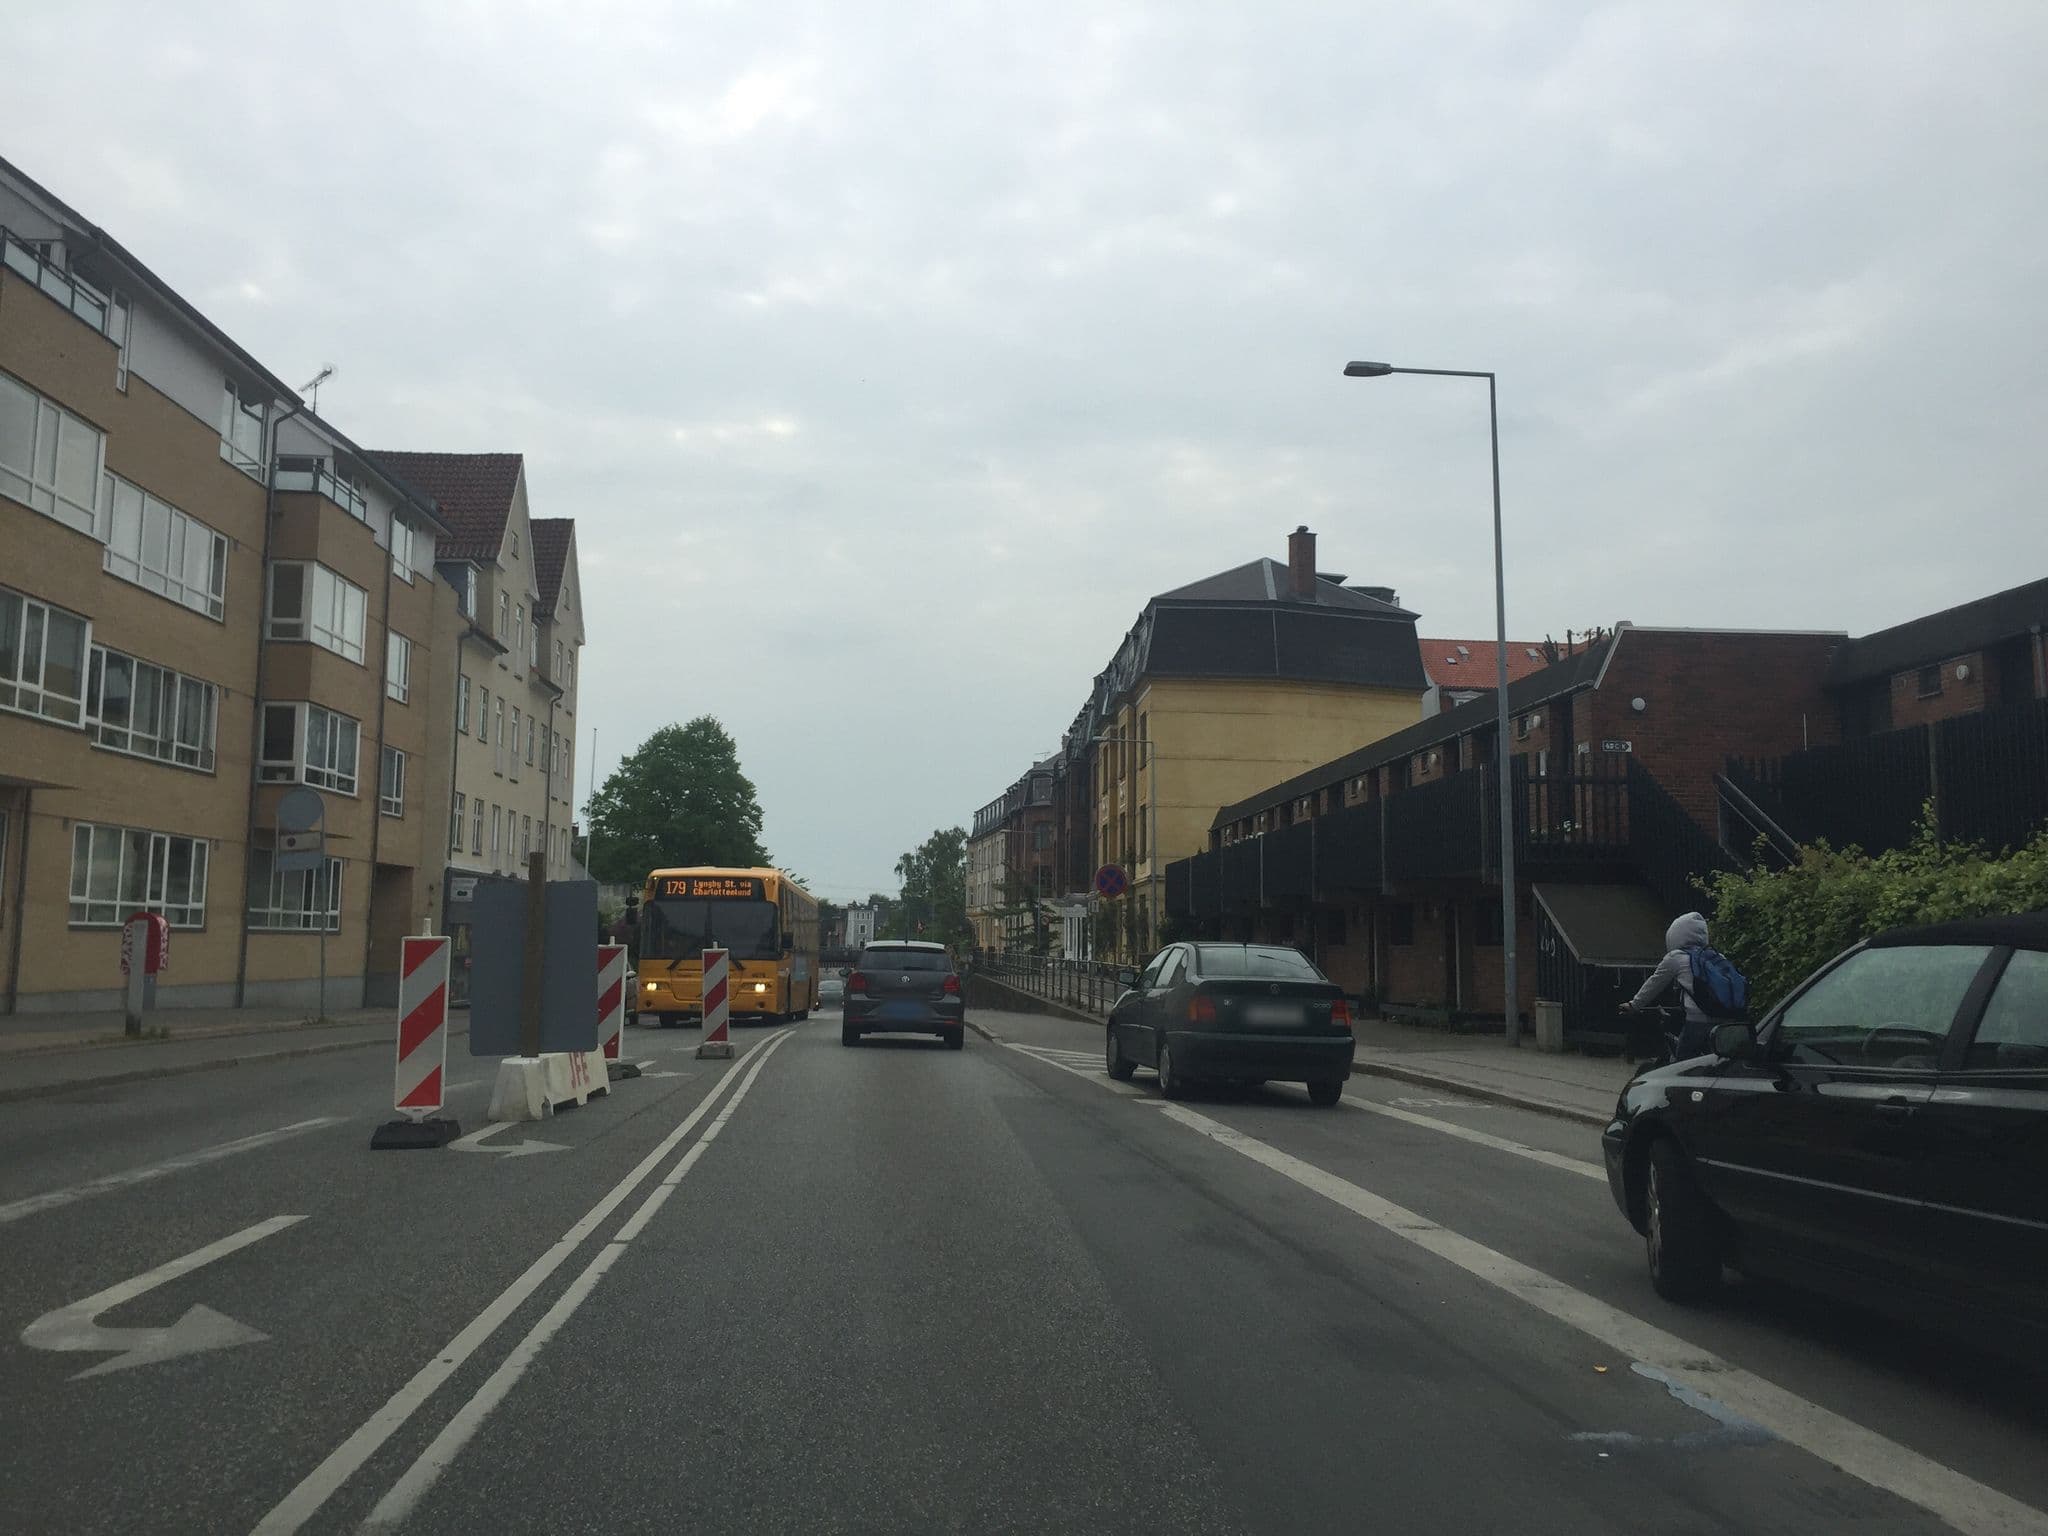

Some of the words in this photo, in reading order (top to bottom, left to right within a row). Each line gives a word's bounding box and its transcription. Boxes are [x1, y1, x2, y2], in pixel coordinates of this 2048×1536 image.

[667, 881, 687, 894] 179
[694, 880, 722, 888] Lyngby
[725, 880, 736, 888] St.
